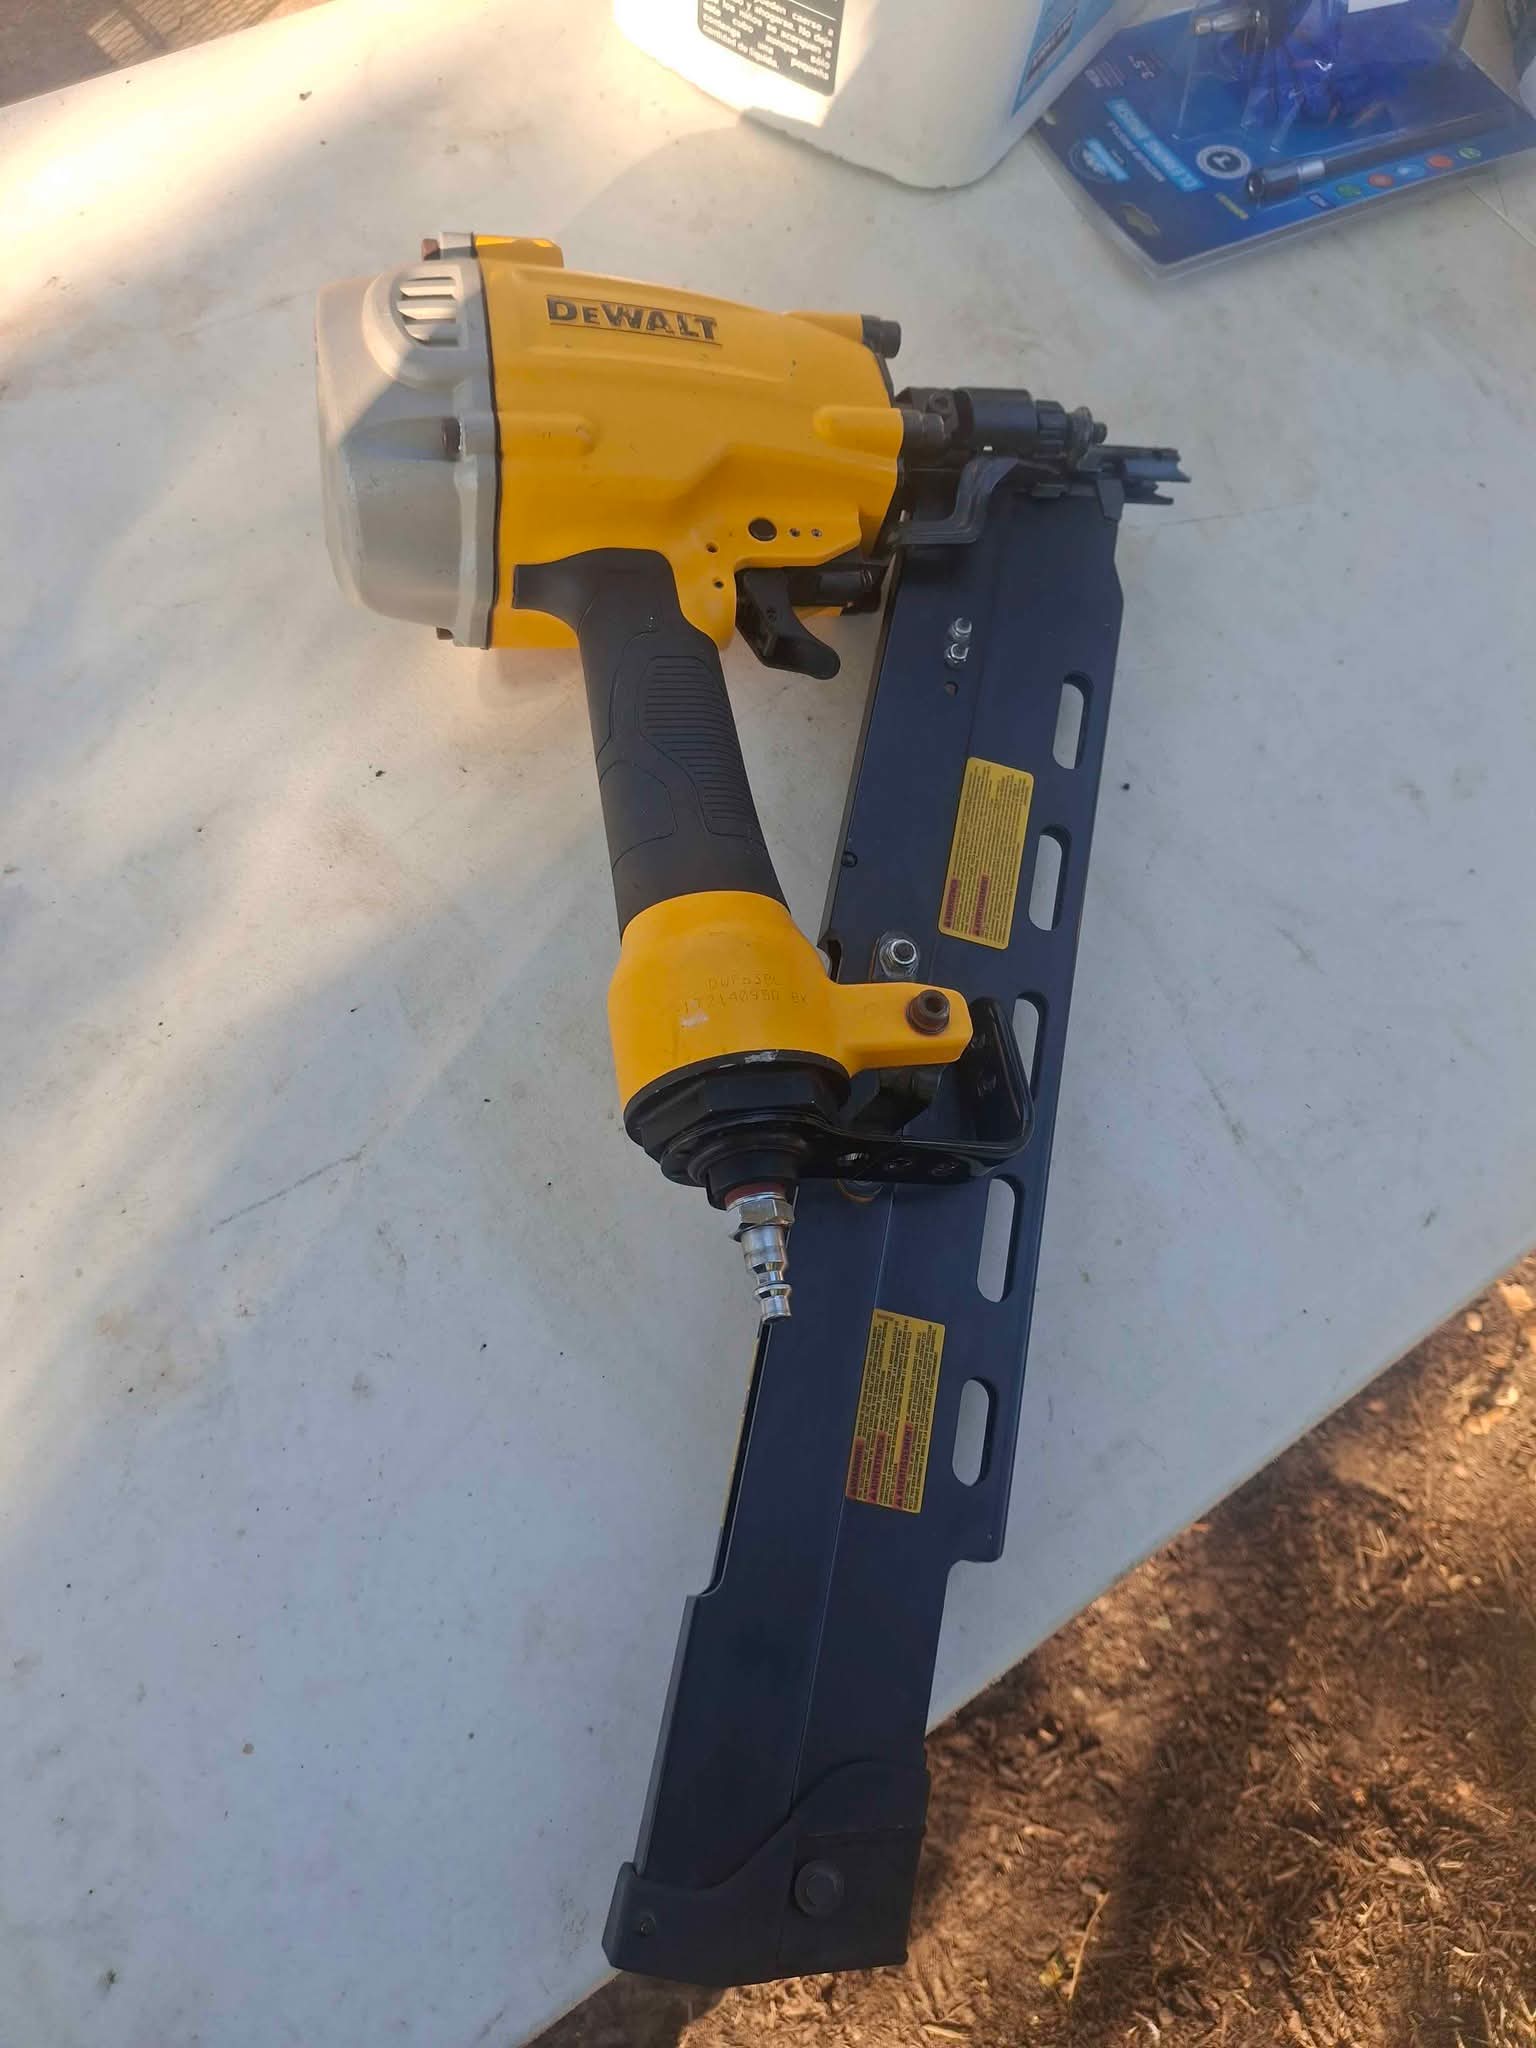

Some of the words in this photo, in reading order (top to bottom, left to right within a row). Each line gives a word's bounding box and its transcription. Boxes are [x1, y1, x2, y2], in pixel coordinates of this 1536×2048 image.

[732, 17, 754, 34] cubo
[766, 23, 777, 34] se
[792, 13, 822, 31] caerse
[798, 25, 811, 38] No
